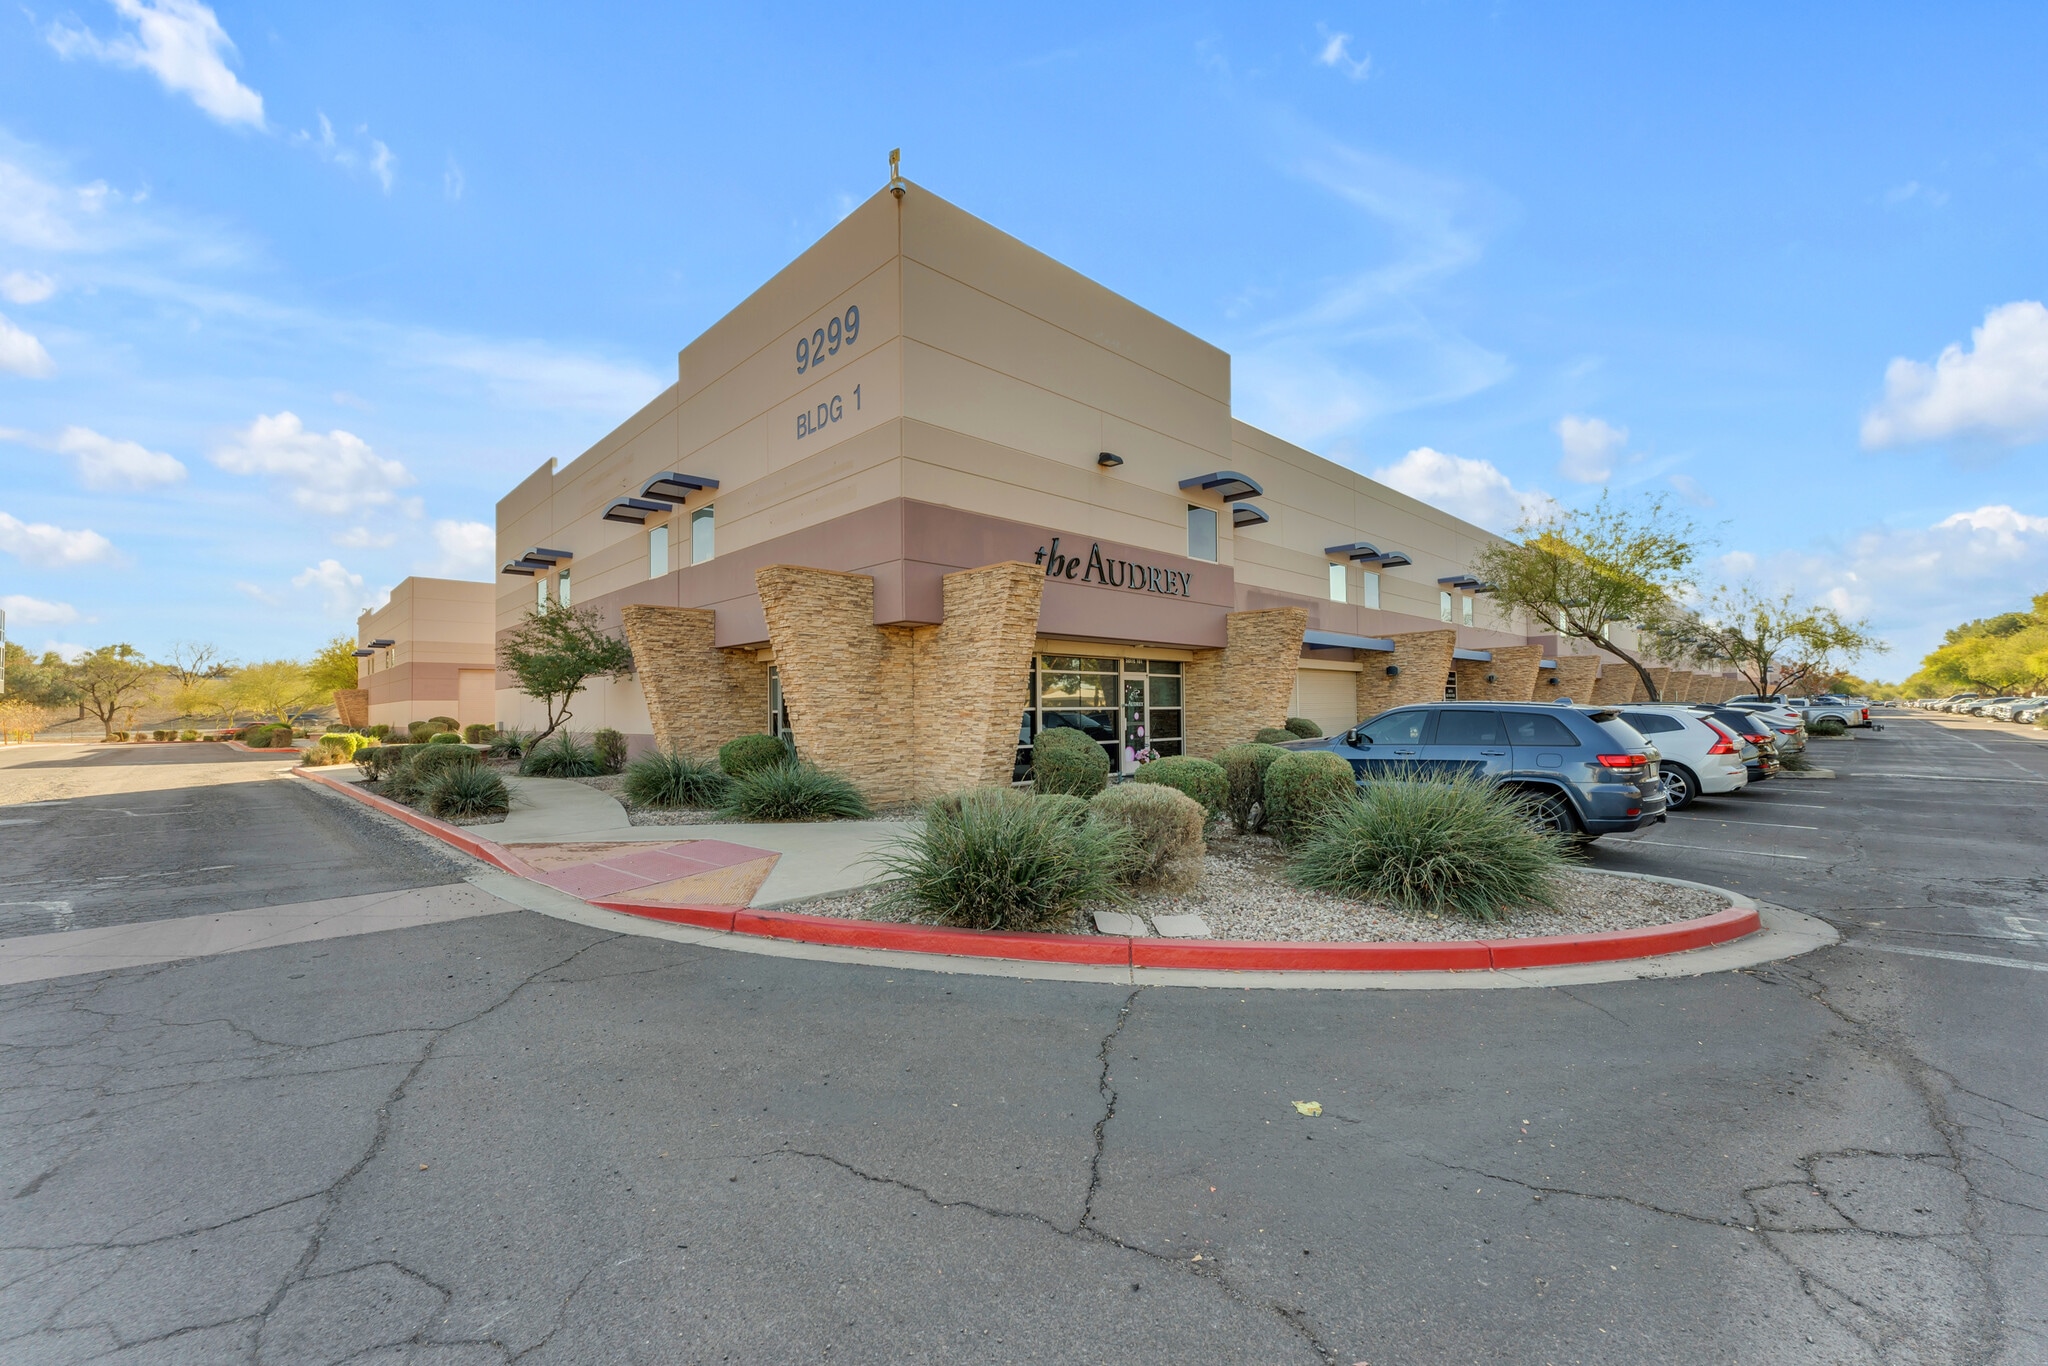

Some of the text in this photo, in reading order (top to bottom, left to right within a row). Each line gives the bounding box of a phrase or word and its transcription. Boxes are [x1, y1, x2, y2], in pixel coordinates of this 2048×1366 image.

[796, 305, 860, 375] 9299
[797, 383, 861, 440] BLDG 1
[1034, 537, 1194, 597] the AUDREY
